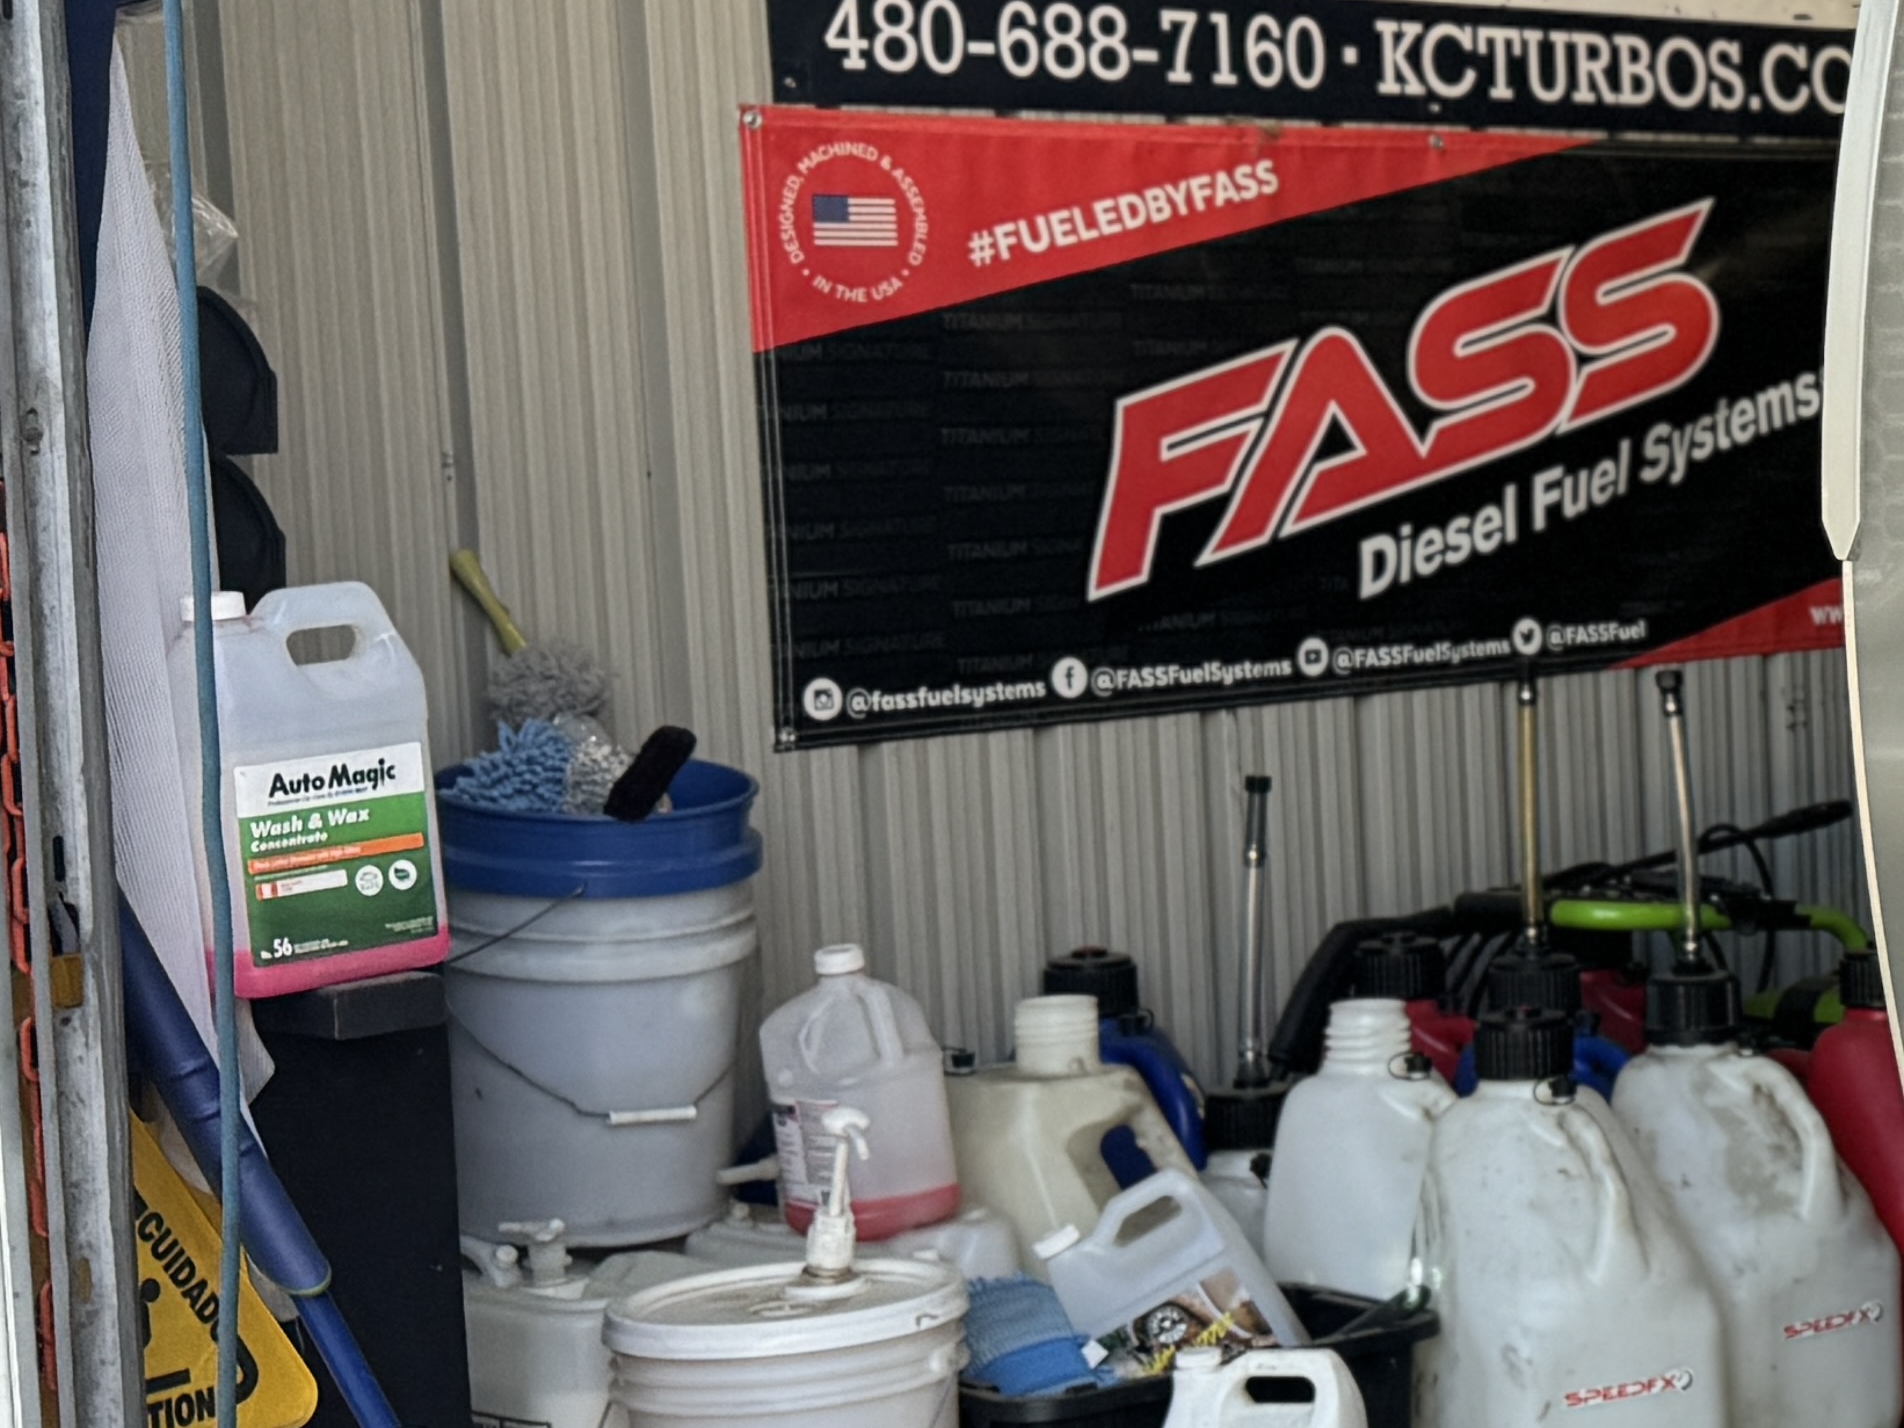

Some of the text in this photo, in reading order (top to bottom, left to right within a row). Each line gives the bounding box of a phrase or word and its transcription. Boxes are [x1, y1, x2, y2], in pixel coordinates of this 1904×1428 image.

[797, 141, 879, 175] MACHINED
[880, 155, 892, 171] &
[892, 168, 929, 267] ASSEMBLED
[966, 158, 1280, 268] #FUELEDBYFASS
[812, 274, 904, 303] IN THE USA
[1088, 198, 1720, 603] FASS
[1358, 372, 1822, 602] Diesel Fuel Systems
[847, 618, 1646, 719] @fassfuelsystems @FASSFuelSystems @FASSFuelSystems @FASSFuel
[250, 808, 370, 839] Wash & Wax
[269, 772, 325, 799] Auto
[328, 757, 397, 791] Magic
[251, 831, 329, 853] Concentrate
[273, 937, 293, 959] 56
[137, 1212, 222, 1343] CUIDAD
